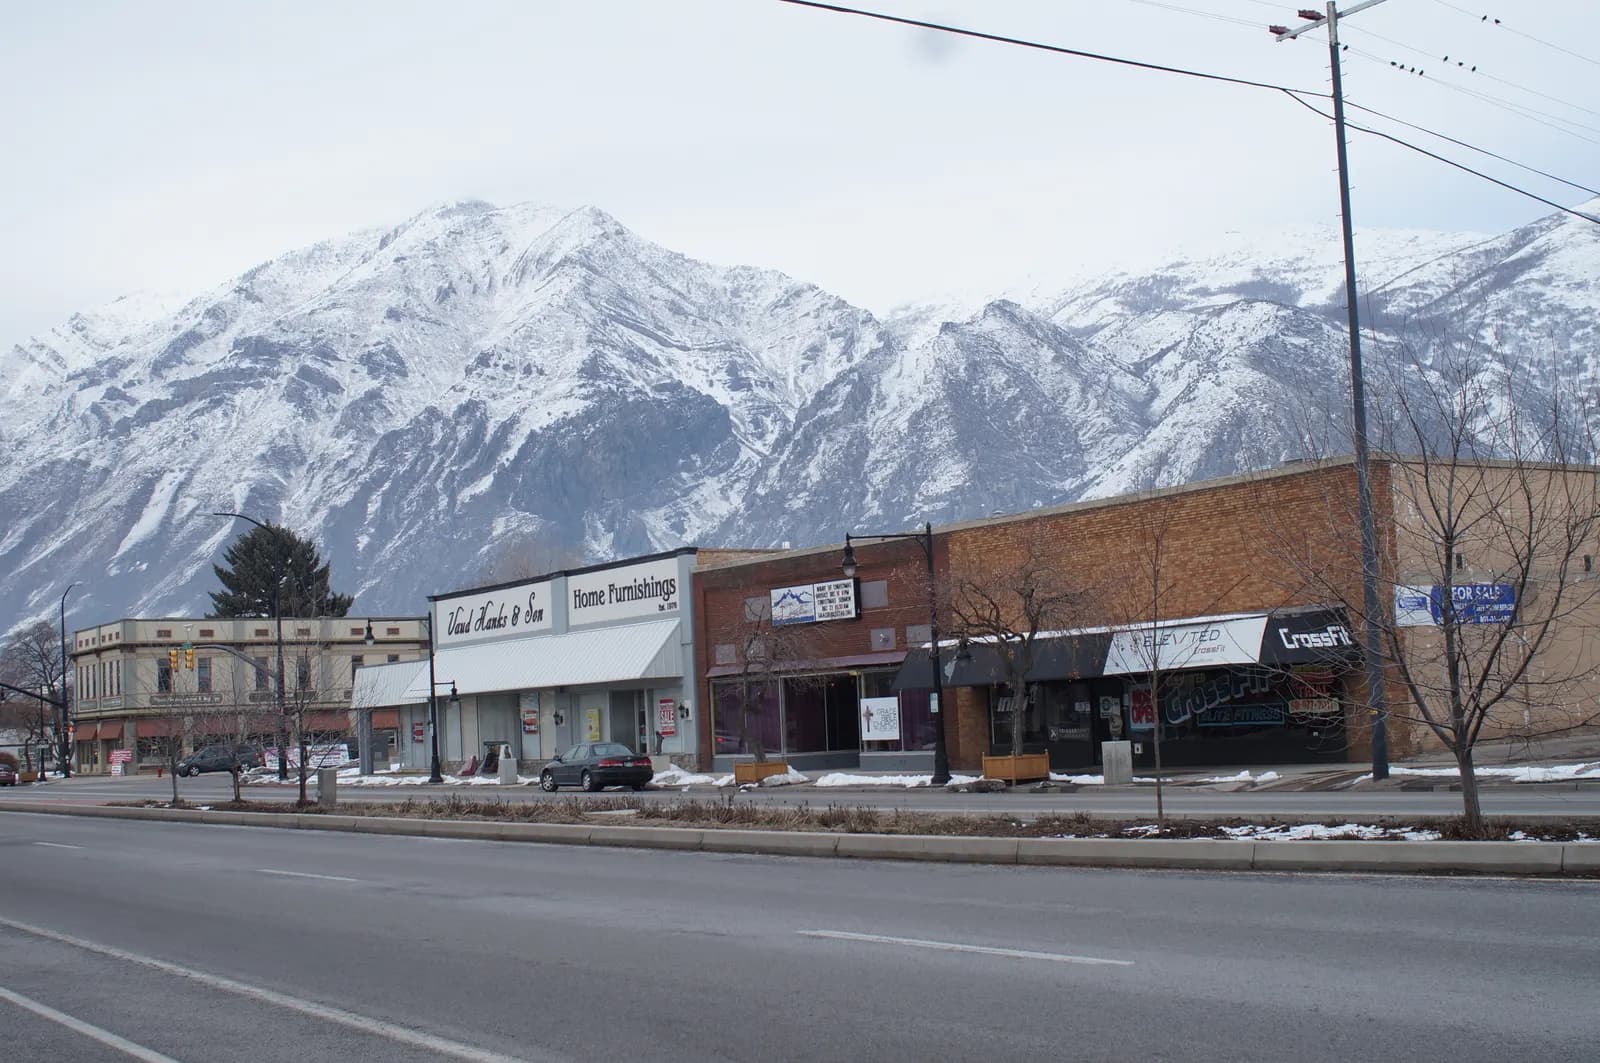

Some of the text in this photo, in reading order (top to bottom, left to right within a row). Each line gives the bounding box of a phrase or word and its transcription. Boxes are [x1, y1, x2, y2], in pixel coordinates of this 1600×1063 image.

[573, 576, 676, 609] Home Furnishings
[1451, 586, 1500, 600] FOR SALE
[448, 591, 544, 635] Vaud Hanks & Son
[1279, 625, 1352, 649] CrossFit
[1132, 704, 1155, 724] OPE
